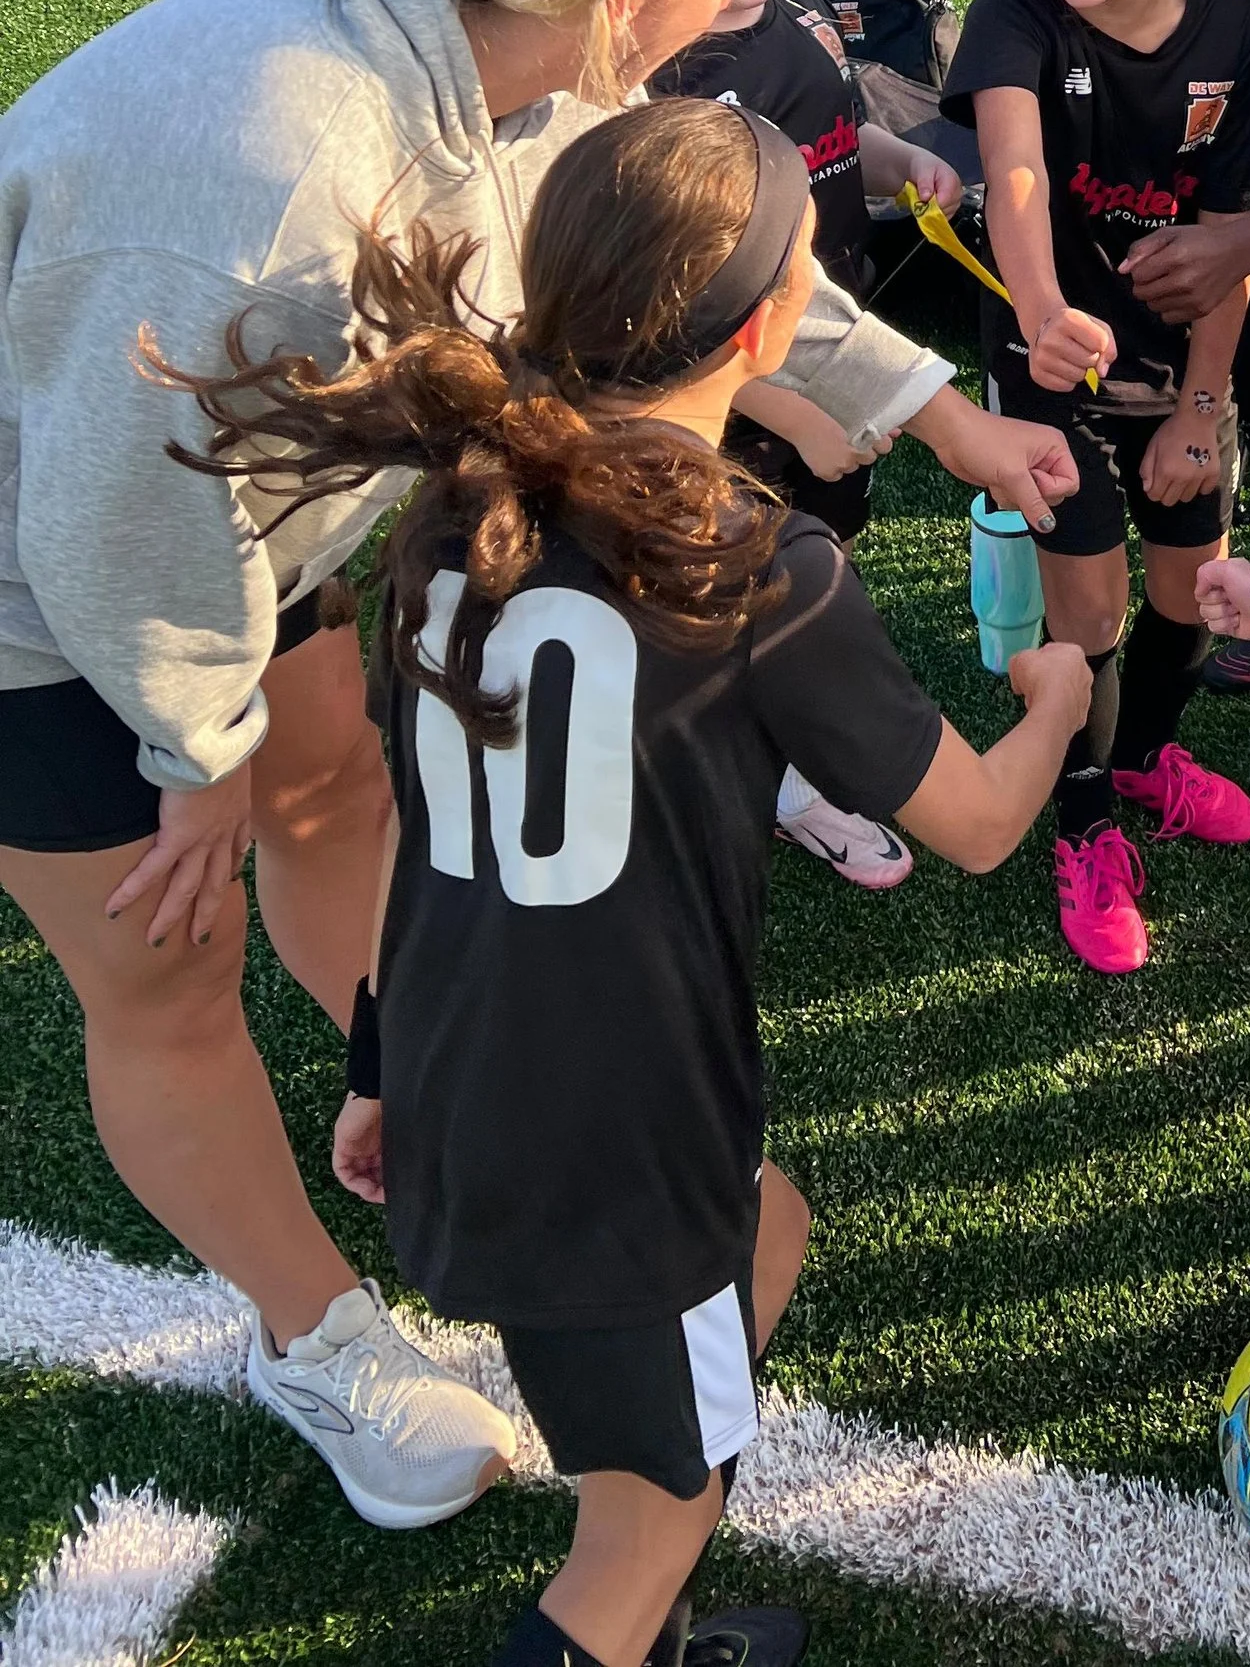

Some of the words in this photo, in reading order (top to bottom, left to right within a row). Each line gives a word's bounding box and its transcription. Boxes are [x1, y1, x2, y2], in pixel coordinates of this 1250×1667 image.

[1188, 81, 1208, 95] DC
[1207, 80, 1236, 95] WAY
[411, 567, 638, 907] 10
